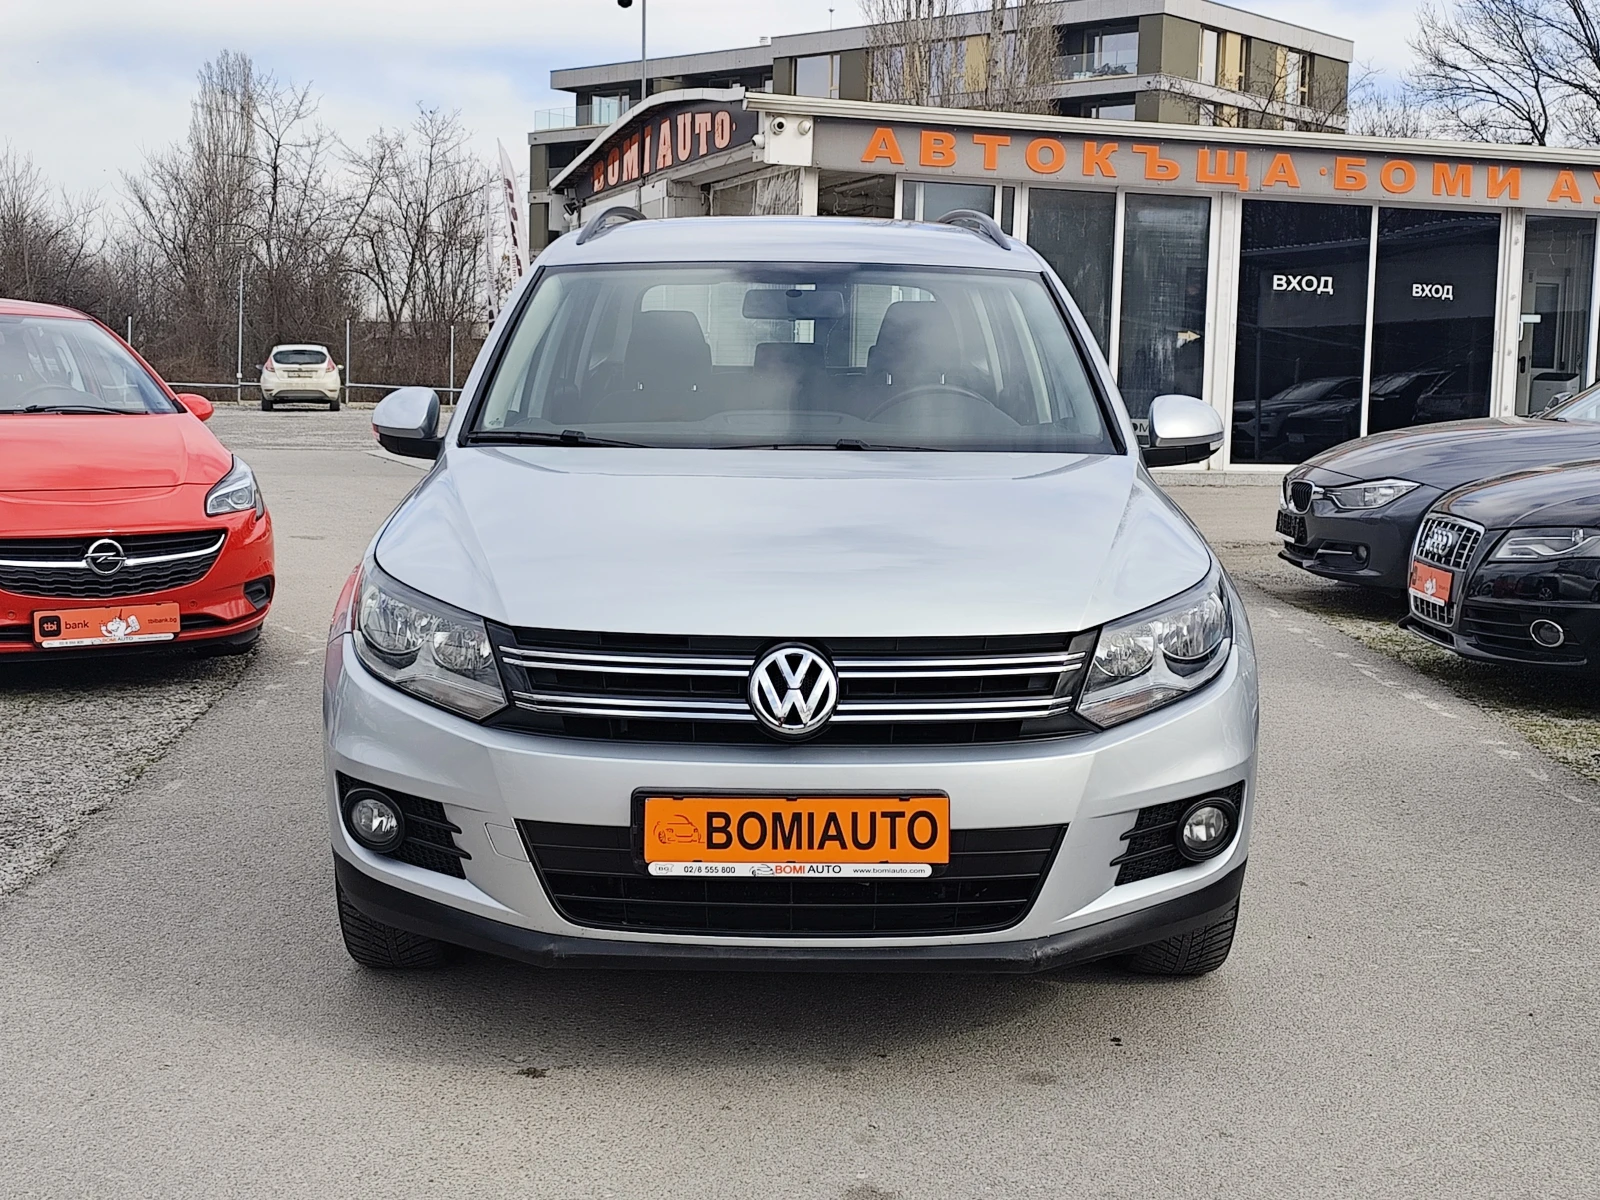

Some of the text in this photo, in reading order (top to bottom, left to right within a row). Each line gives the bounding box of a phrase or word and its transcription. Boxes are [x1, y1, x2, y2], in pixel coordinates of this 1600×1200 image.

[860, 127, 1300, 192] АВТОКЪЩА
[1547, 170, 1600, 204] А
[1272, 274, 1334, 295] ВХОД
[1412, 283, 1454, 300] ВХОД
[43, 620, 89, 631] tbi bank
[706, 810, 938, 851] BOMIAUTO
[721, 866, 736, 874] 800
[775, 865, 842, 874] BOMI AUTO
[853, 865, 925, 874] www.bomiauto.com
